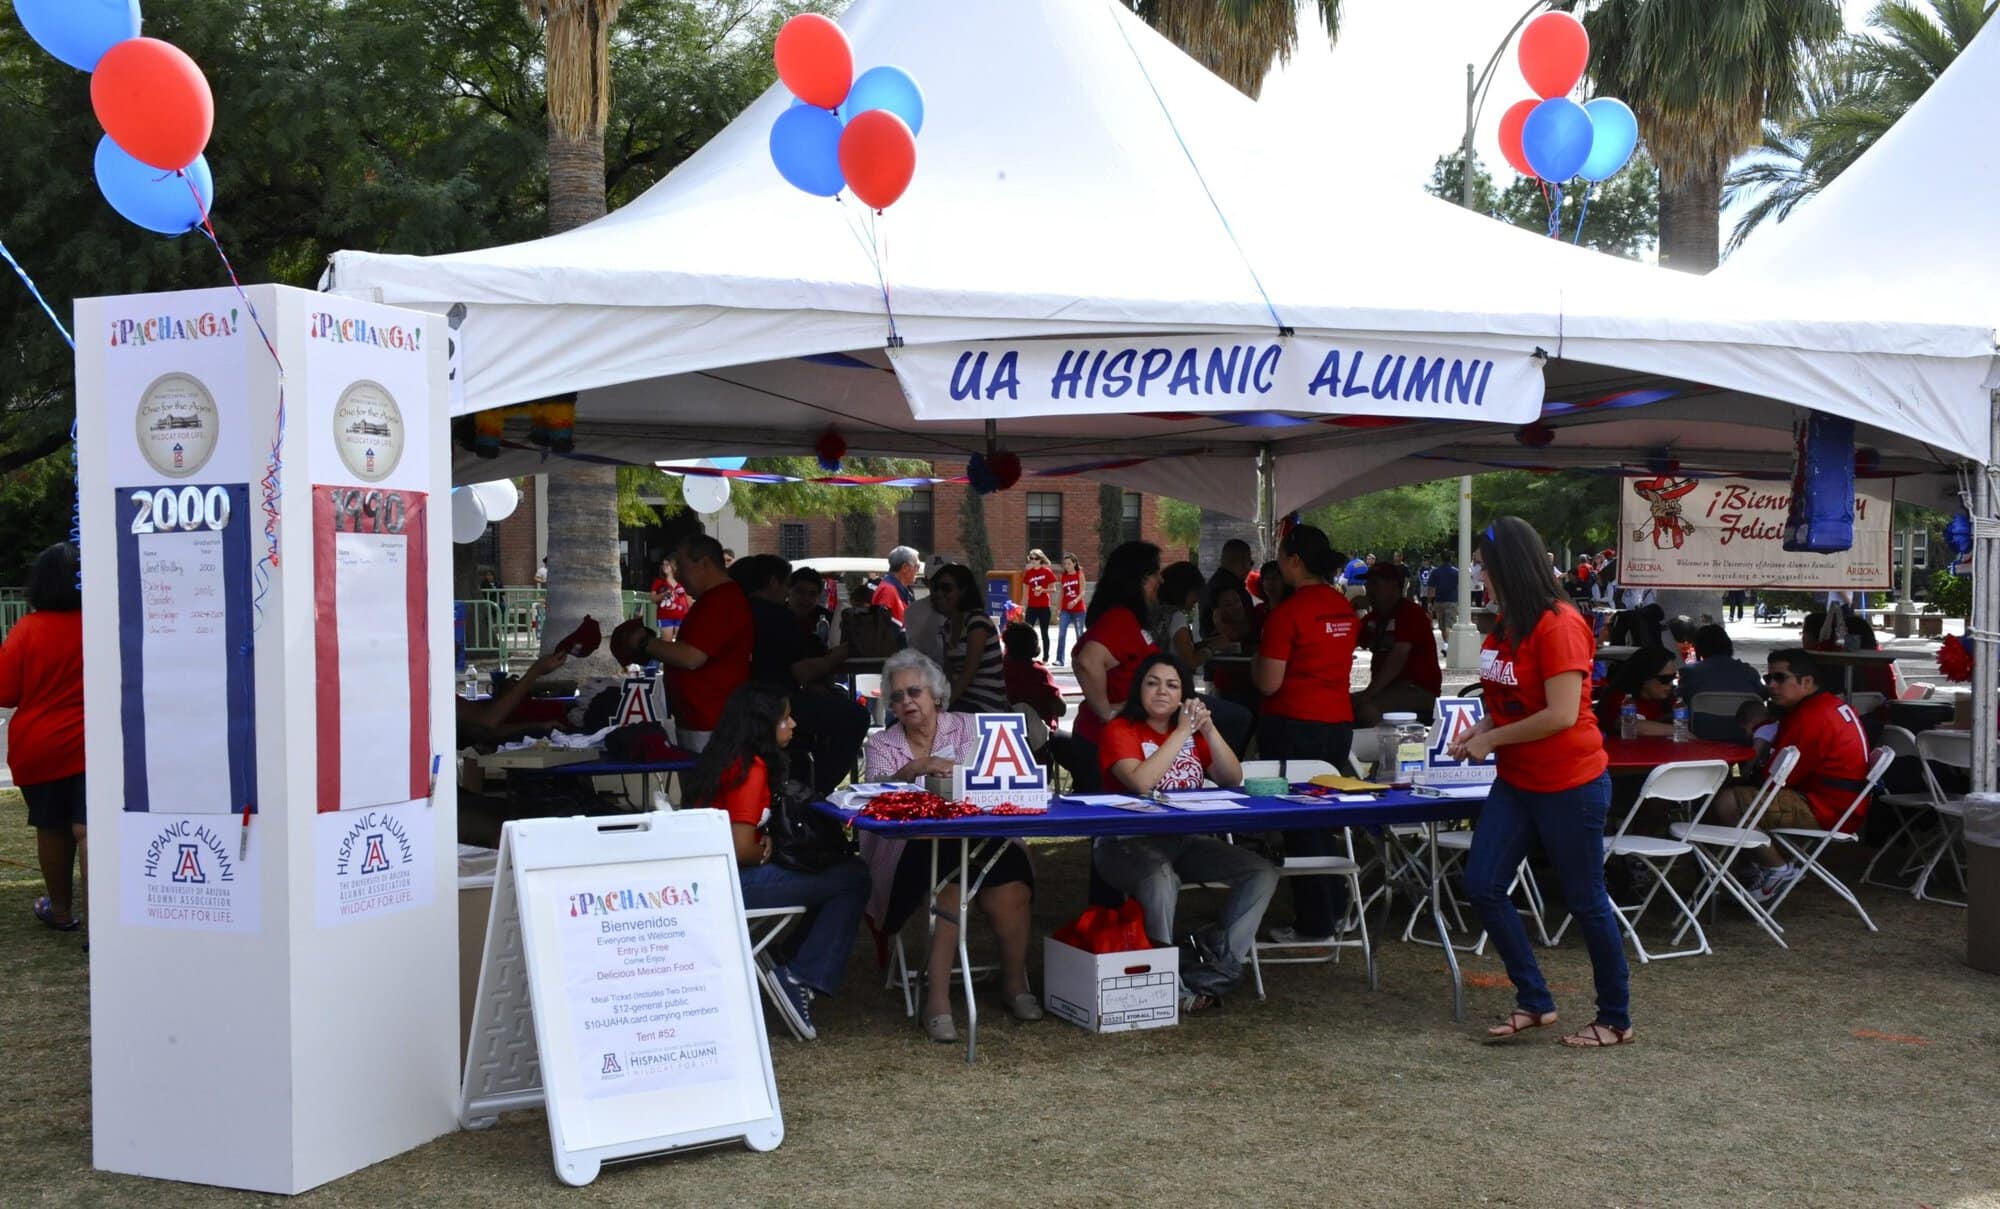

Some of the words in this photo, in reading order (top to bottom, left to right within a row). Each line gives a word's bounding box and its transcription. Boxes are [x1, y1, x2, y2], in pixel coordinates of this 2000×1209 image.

[111, 308, 238, 347] ¡PACHANGA!
[311, 312, 421, 351] ¡PACHANGA!
[950, 351, 1021, 401] UA
[1051, 344, 1282, 399] HISPANIC
[1308, 350, 1494, 406] ALUMNI
[131, 486, 230, 534] 2000
[332, 489, 405, 534] 1990
[1706, 485, 1792, 518] ¡Bienv
[1720, 514, 1784, 545] Felici
[964, 714, 1046, 790] A
[144, 820, 190, 877] HISPANIC
[194, 823, 235, 881] ALUMNI
[336, 812, 376, 875] HISPANIC
[380, 813, 413, 863] ALUMNI
[361, 834, 390, 874] A
[172, 843, 205, 883] A
[148, 907, 188, 920] WILDCAT
[191, 910, 210, 921] FOR
[340, 898, 376, 915] WILDCAT
[377, 894, 395, 906] FOR
[569, 882, 700, 917] ¡PACHANGA!
[597, 935, 637, 946] Everyone
[639, 934, 645, 942] is
[647, 930, 685, 941] Welcome
[601, 916, 678, 933] Bienvenidos
[617, 946, 639, 957] Entry
[641, 945, 648, 953] is
[650, 943, 669, 953] Free
[646, 955, 665, 964] Enjoy
[597, 970, 636, 981] Delicious
[637, 966, 671, 976] Mexican
[674, 962, 694, 972] Food
[584, 1017, 629, 1030] $10-UAHA
[631, 1015, 647, 1024] card
[649, 1011, 681, 1023] carrying
[682, 1006, 719, 1017] members
[613, 1001, 663, 1014] $12-general
[665, 998, 689, 1008] public
[637, 1031, 656, 1041] Tent
[658, 1028, 676, 1039] #52
[630, 1051, 678, 1067] HISPANIC
[679, 1047, 717, 1060] ALUMNI
